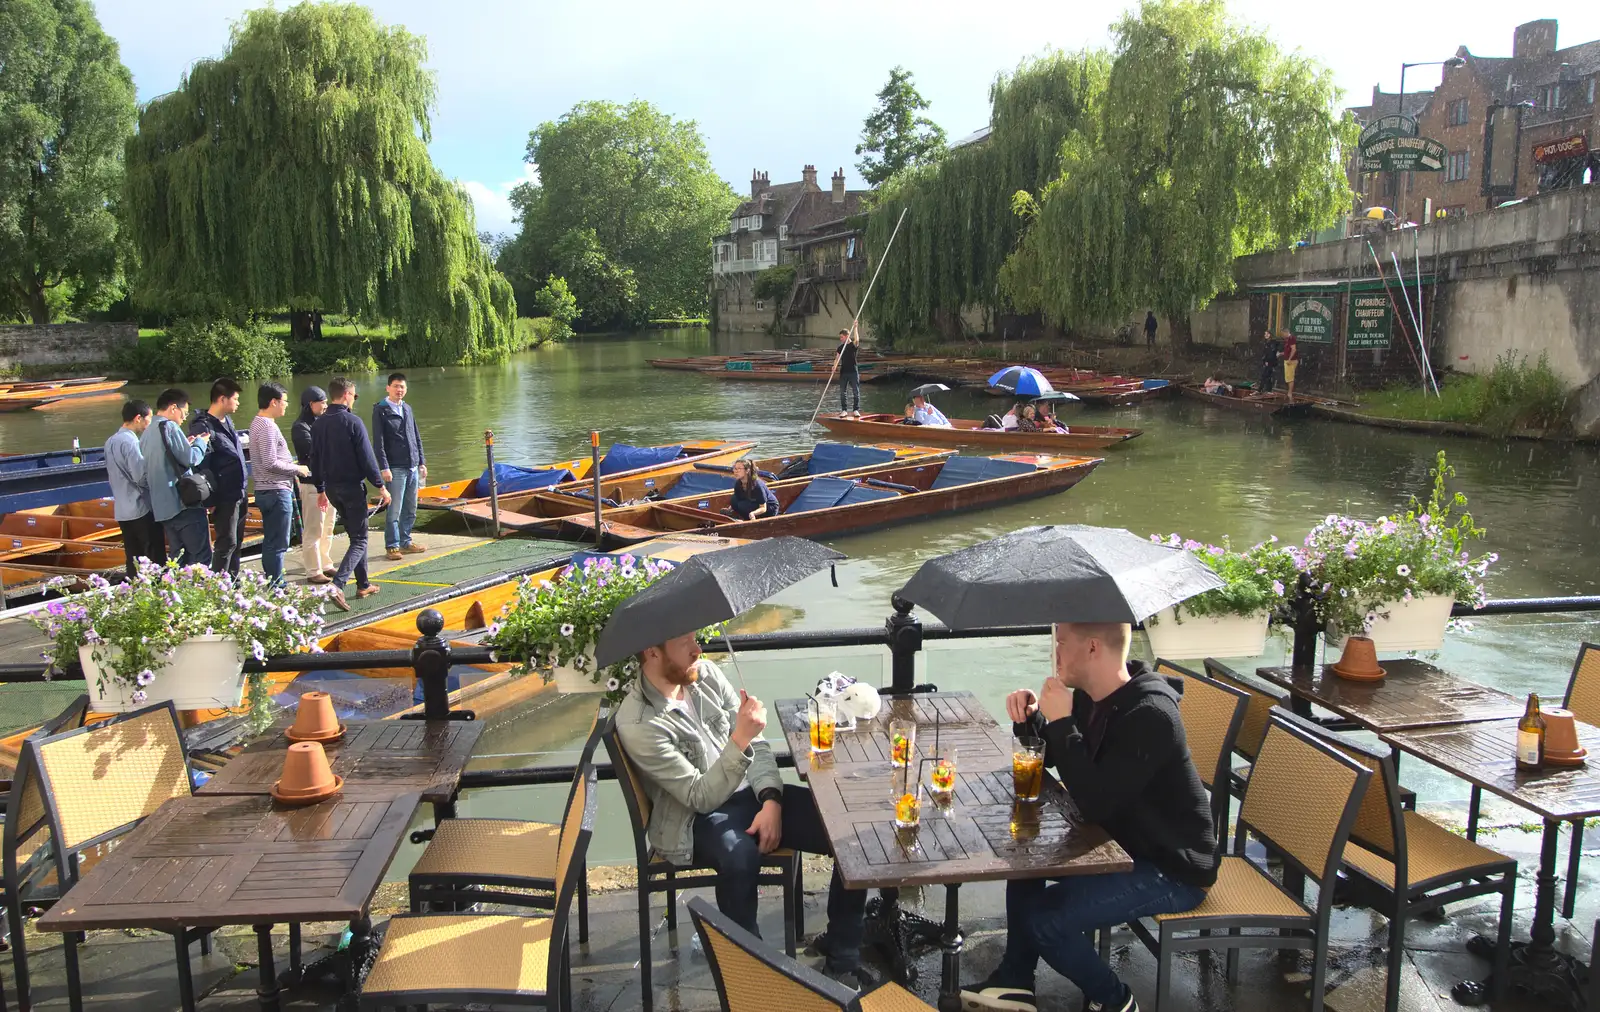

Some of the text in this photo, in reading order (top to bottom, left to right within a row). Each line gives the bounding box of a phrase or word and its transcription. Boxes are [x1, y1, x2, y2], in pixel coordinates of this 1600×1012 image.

[1365, 137, 1442, 158] CAMBRIDGE CHAUFFEUR PUNTS
[1544, 142, 1572, 155] HOT DOG
[1355, 298, 1386, 307] CAMBRIDGE
[1355, 308, 1385, 318] CHAUFFEUR
[1299, 317, 1310, 325] RIVER
[1360, 319, 1378, 328] PUNTS
[1295, 325, 1303, 333] SELF
[1313, 326, 1326, 334] PUNTS
